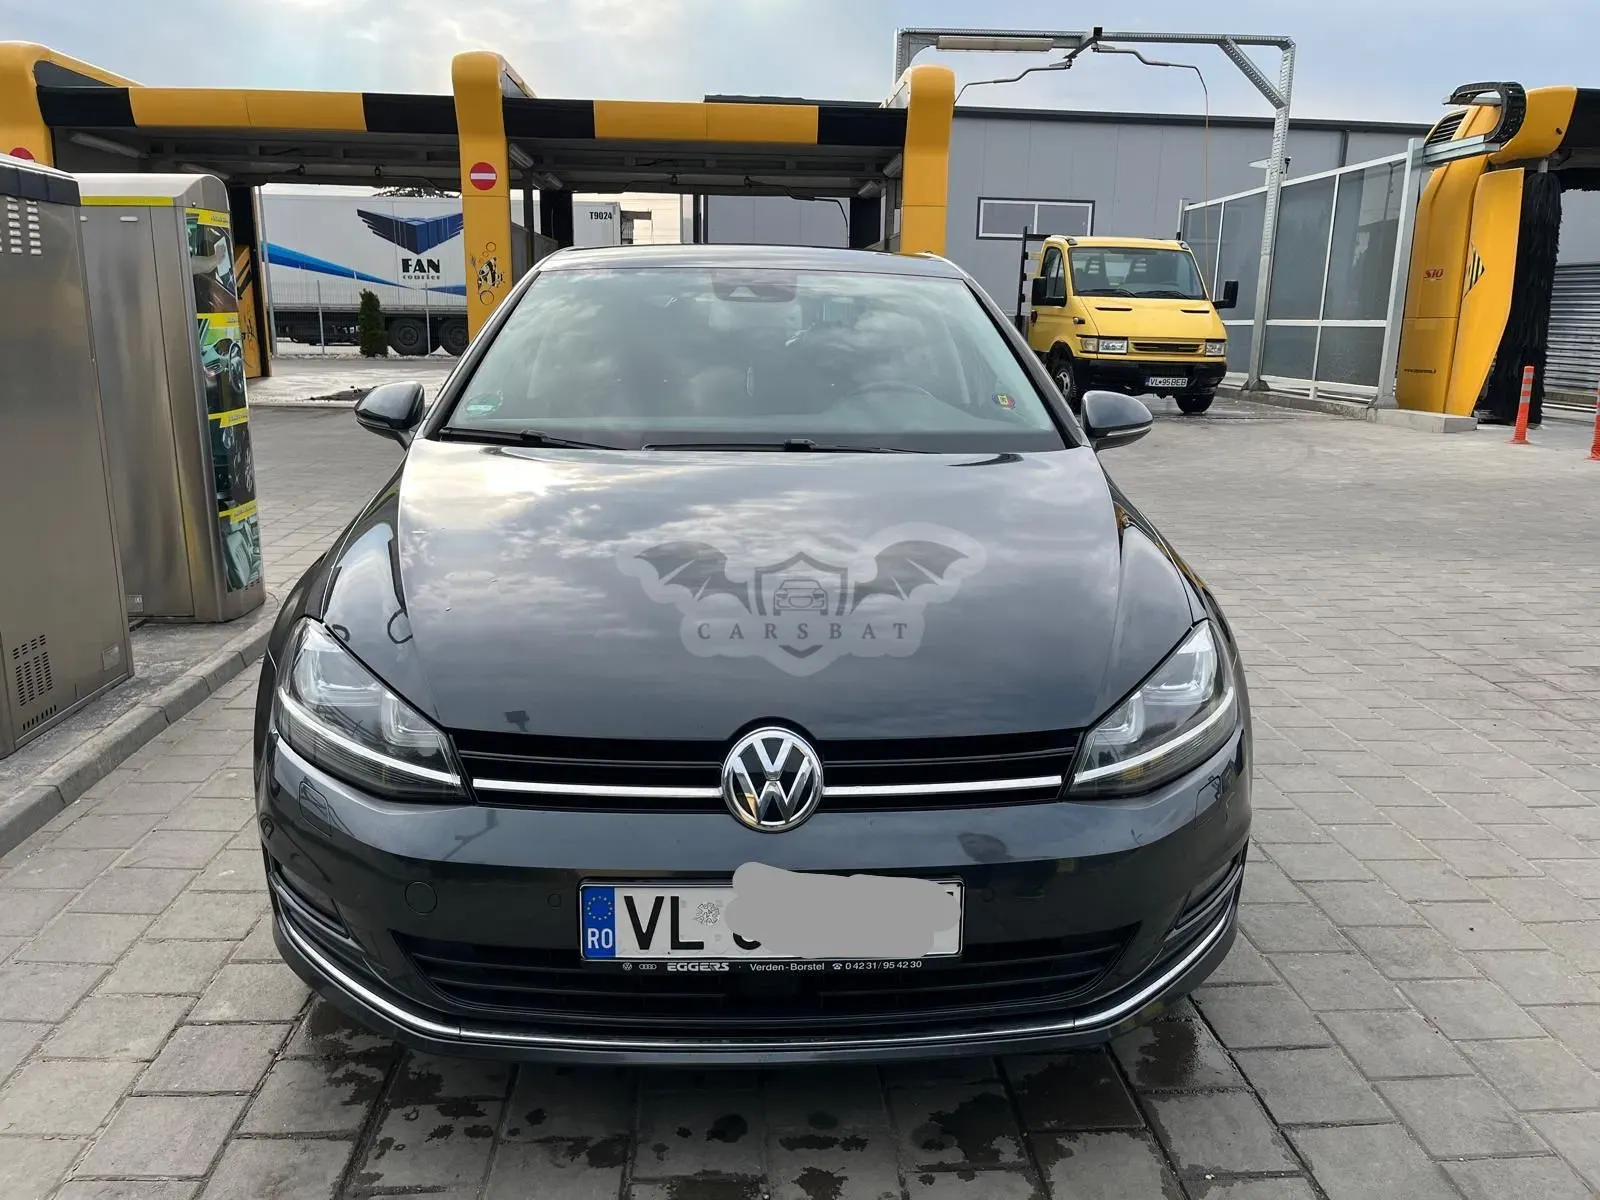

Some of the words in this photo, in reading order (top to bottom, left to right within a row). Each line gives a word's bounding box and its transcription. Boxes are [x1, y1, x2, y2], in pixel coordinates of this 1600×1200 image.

[589, 211, 613, 220] T9024
[401, 258, 441, 273] FAN
[623, 895, 705, 951] VL
[587, 928, 613, 949] RO
[666, 962, 730, 972] EGGERS
